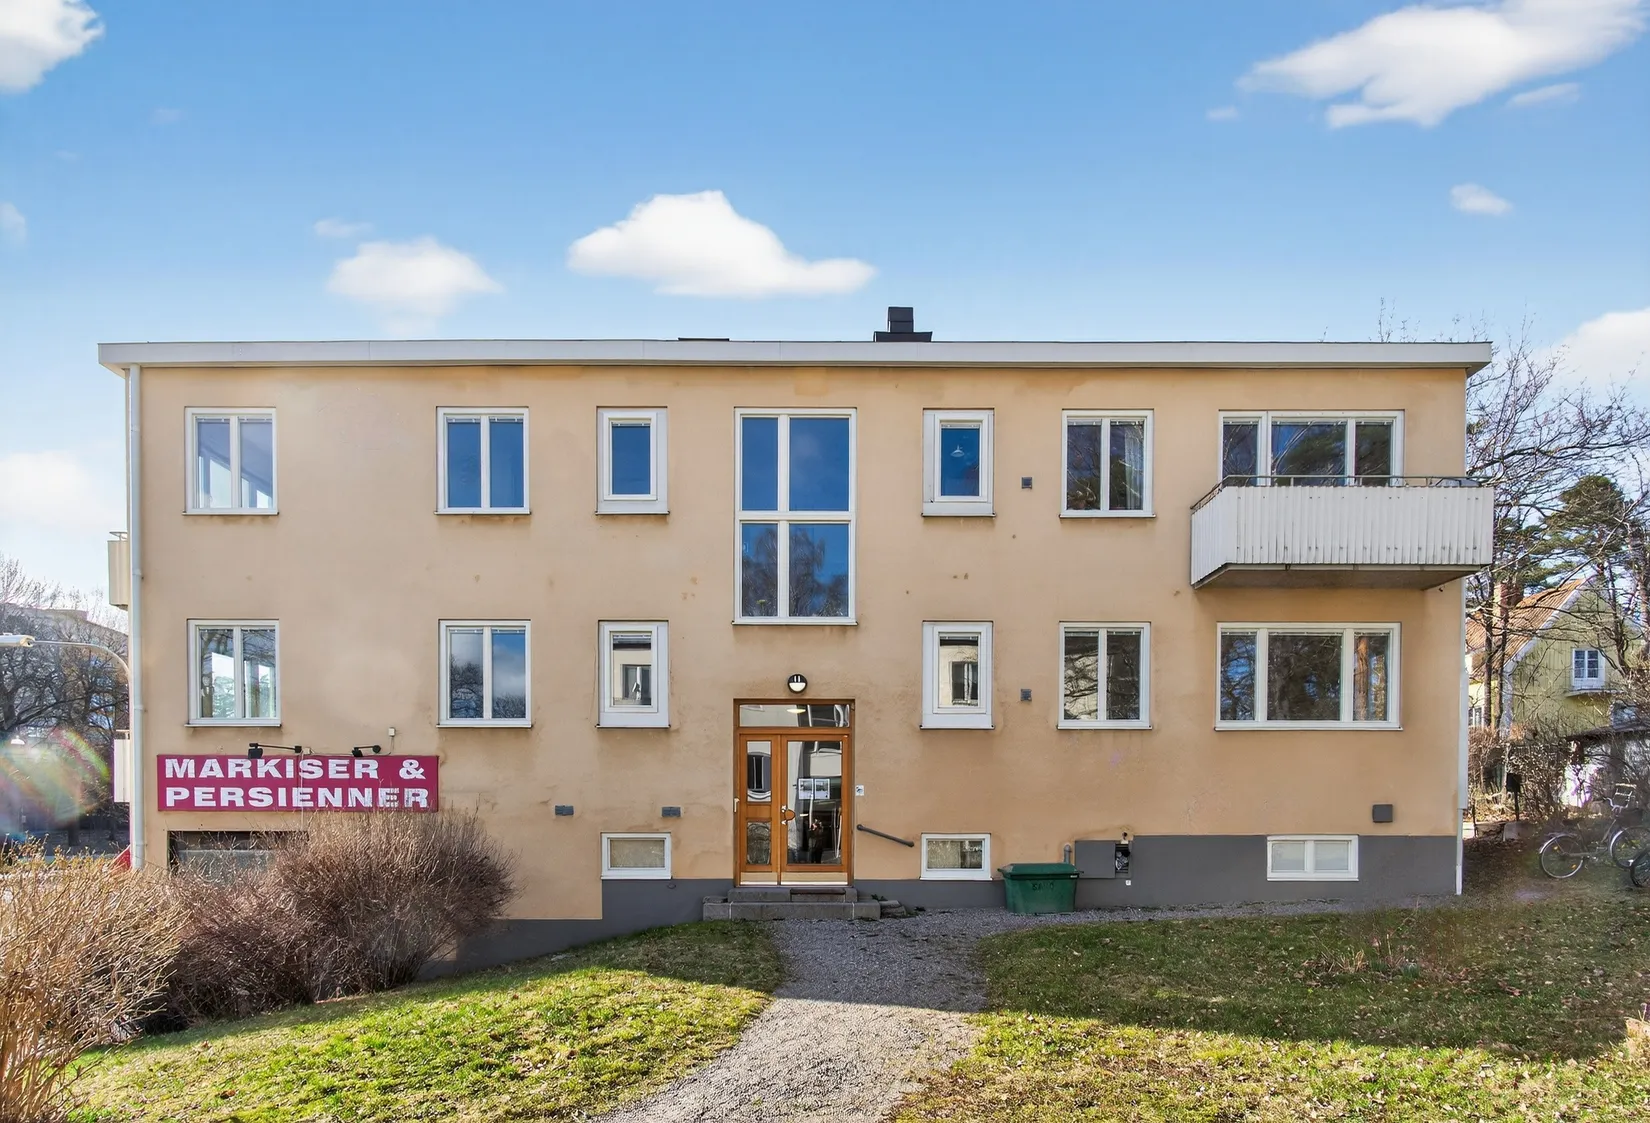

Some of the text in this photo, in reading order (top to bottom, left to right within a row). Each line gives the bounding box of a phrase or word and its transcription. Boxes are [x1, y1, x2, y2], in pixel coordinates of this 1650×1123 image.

[165, 758, 426, 779] MARKISER &
[166, 787, 429, 808] PERSIENNER
